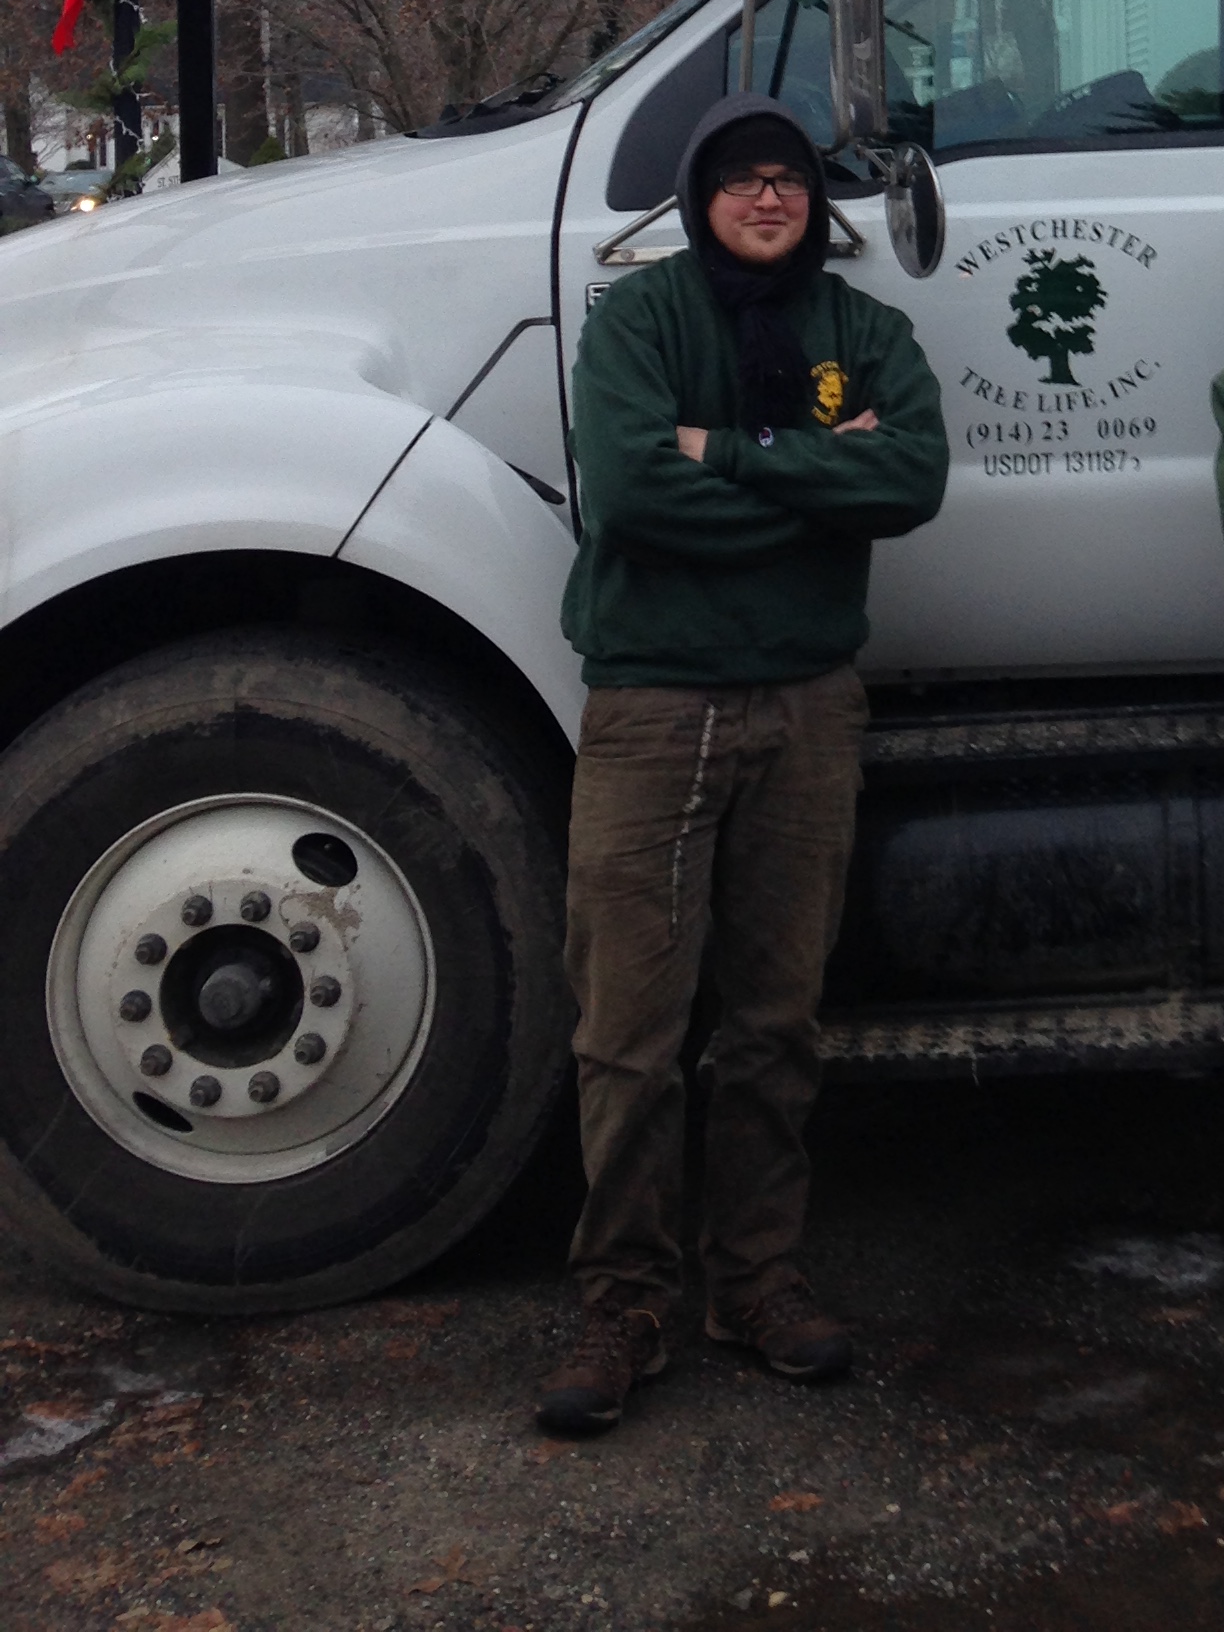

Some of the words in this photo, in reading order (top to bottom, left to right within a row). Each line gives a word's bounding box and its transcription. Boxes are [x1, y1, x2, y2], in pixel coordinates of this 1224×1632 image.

[954, 218, 1158, 277] WESTCHESTER
[958, 366, 1029, 411] TREE
[966, 421, 1033, 449] (914)
[984, 452, 1054, 477] USDOT
